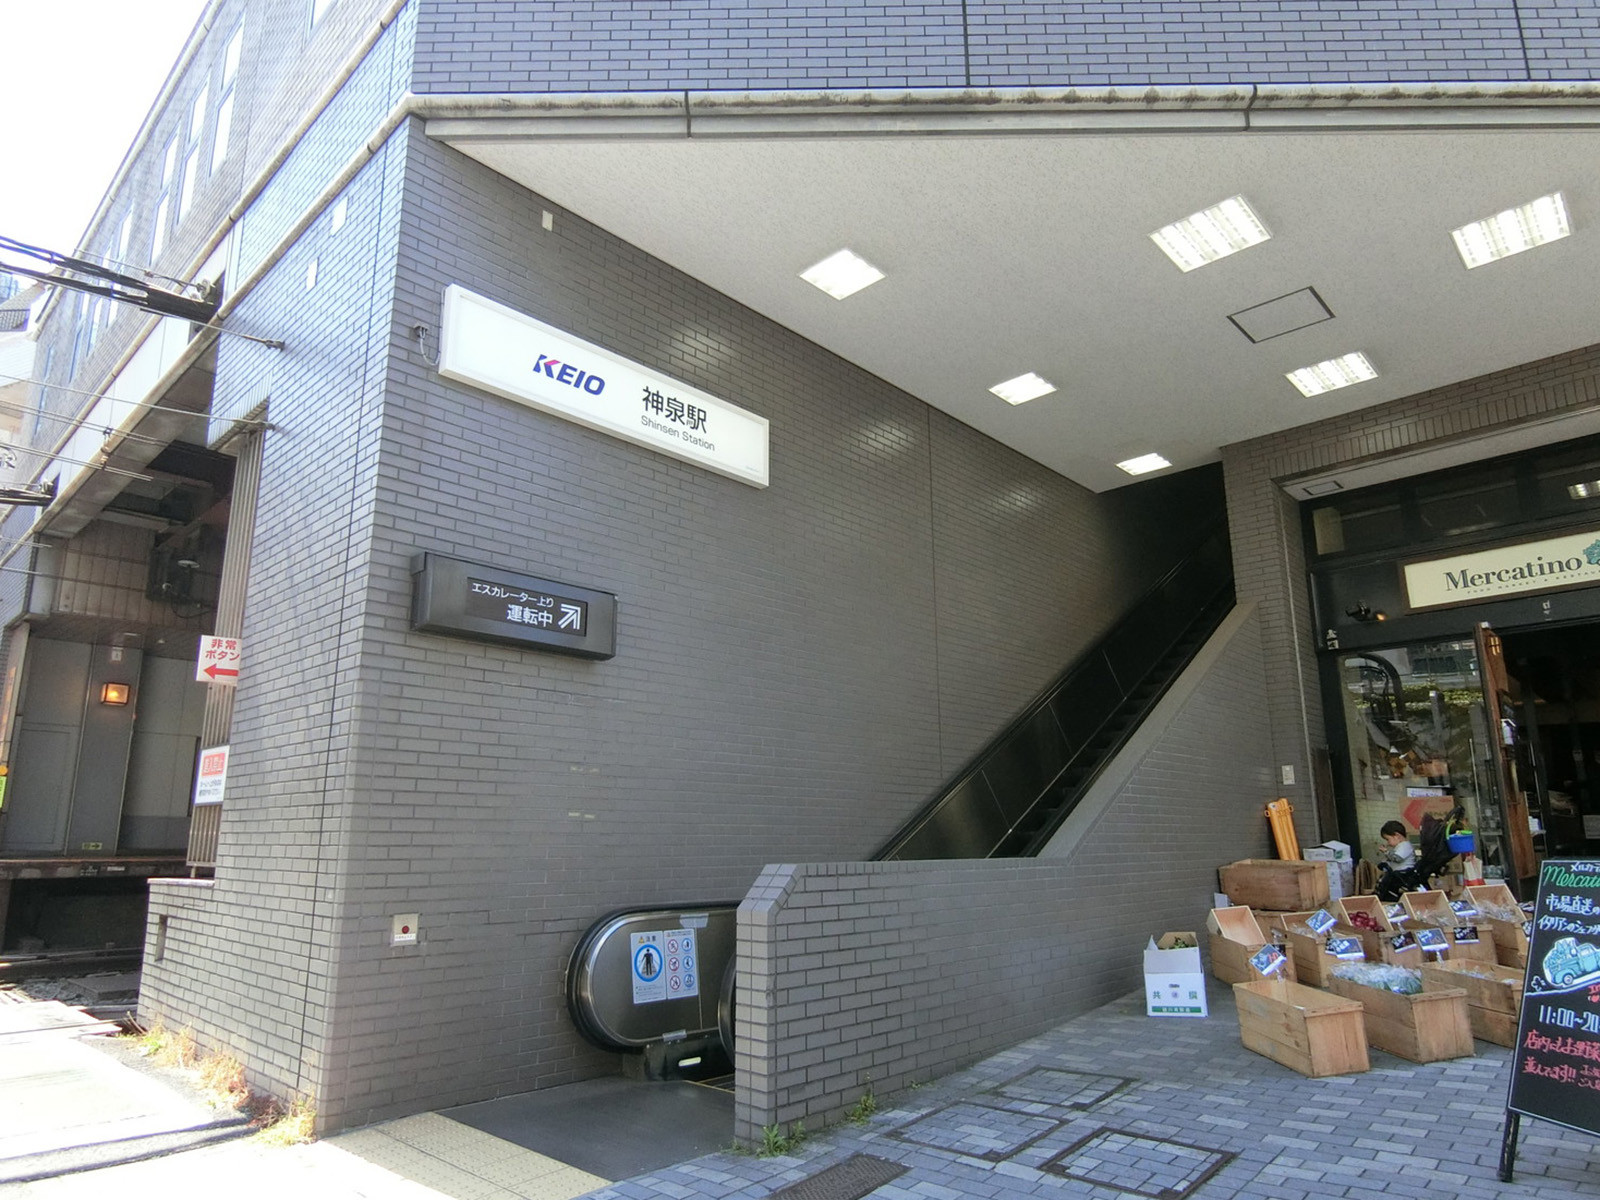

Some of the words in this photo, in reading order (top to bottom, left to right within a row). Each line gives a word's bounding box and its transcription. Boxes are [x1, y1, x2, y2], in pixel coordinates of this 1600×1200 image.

[533, 354, 606, 396] KEIO
[642, 386, 707, 434] 神泉駅
[641, 414, 680, 439] Shinsen
[682, 432, 715, 452] Station
[1443, 556, 1582, 591] Mercatino
[472, 582, 554, 608] エスカレーター上り
[507, 604, 553, 628] 運転中
[205, 650, 240, 661] ボタン
[210, 638, 237, 650] 非常
